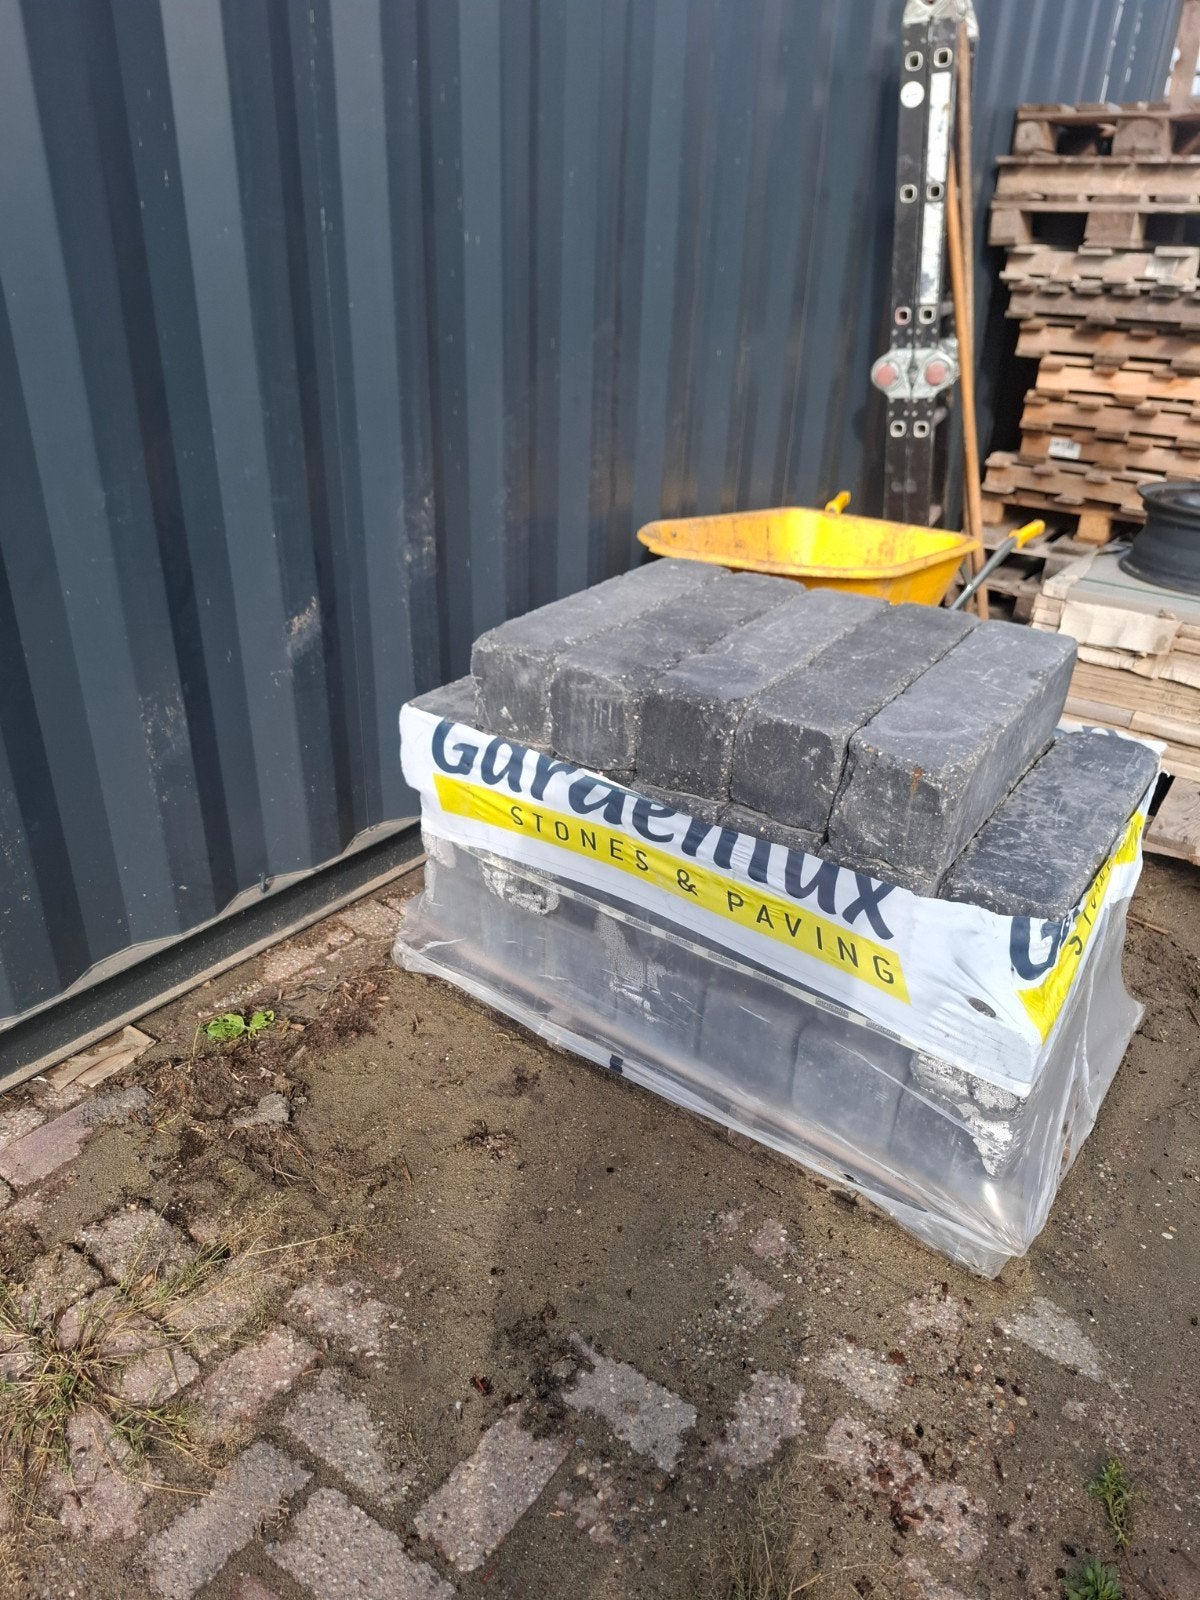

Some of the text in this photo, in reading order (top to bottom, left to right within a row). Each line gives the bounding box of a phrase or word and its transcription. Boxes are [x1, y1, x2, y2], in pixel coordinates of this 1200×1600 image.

[510, 805, 895, 985] STONES & PAVING
